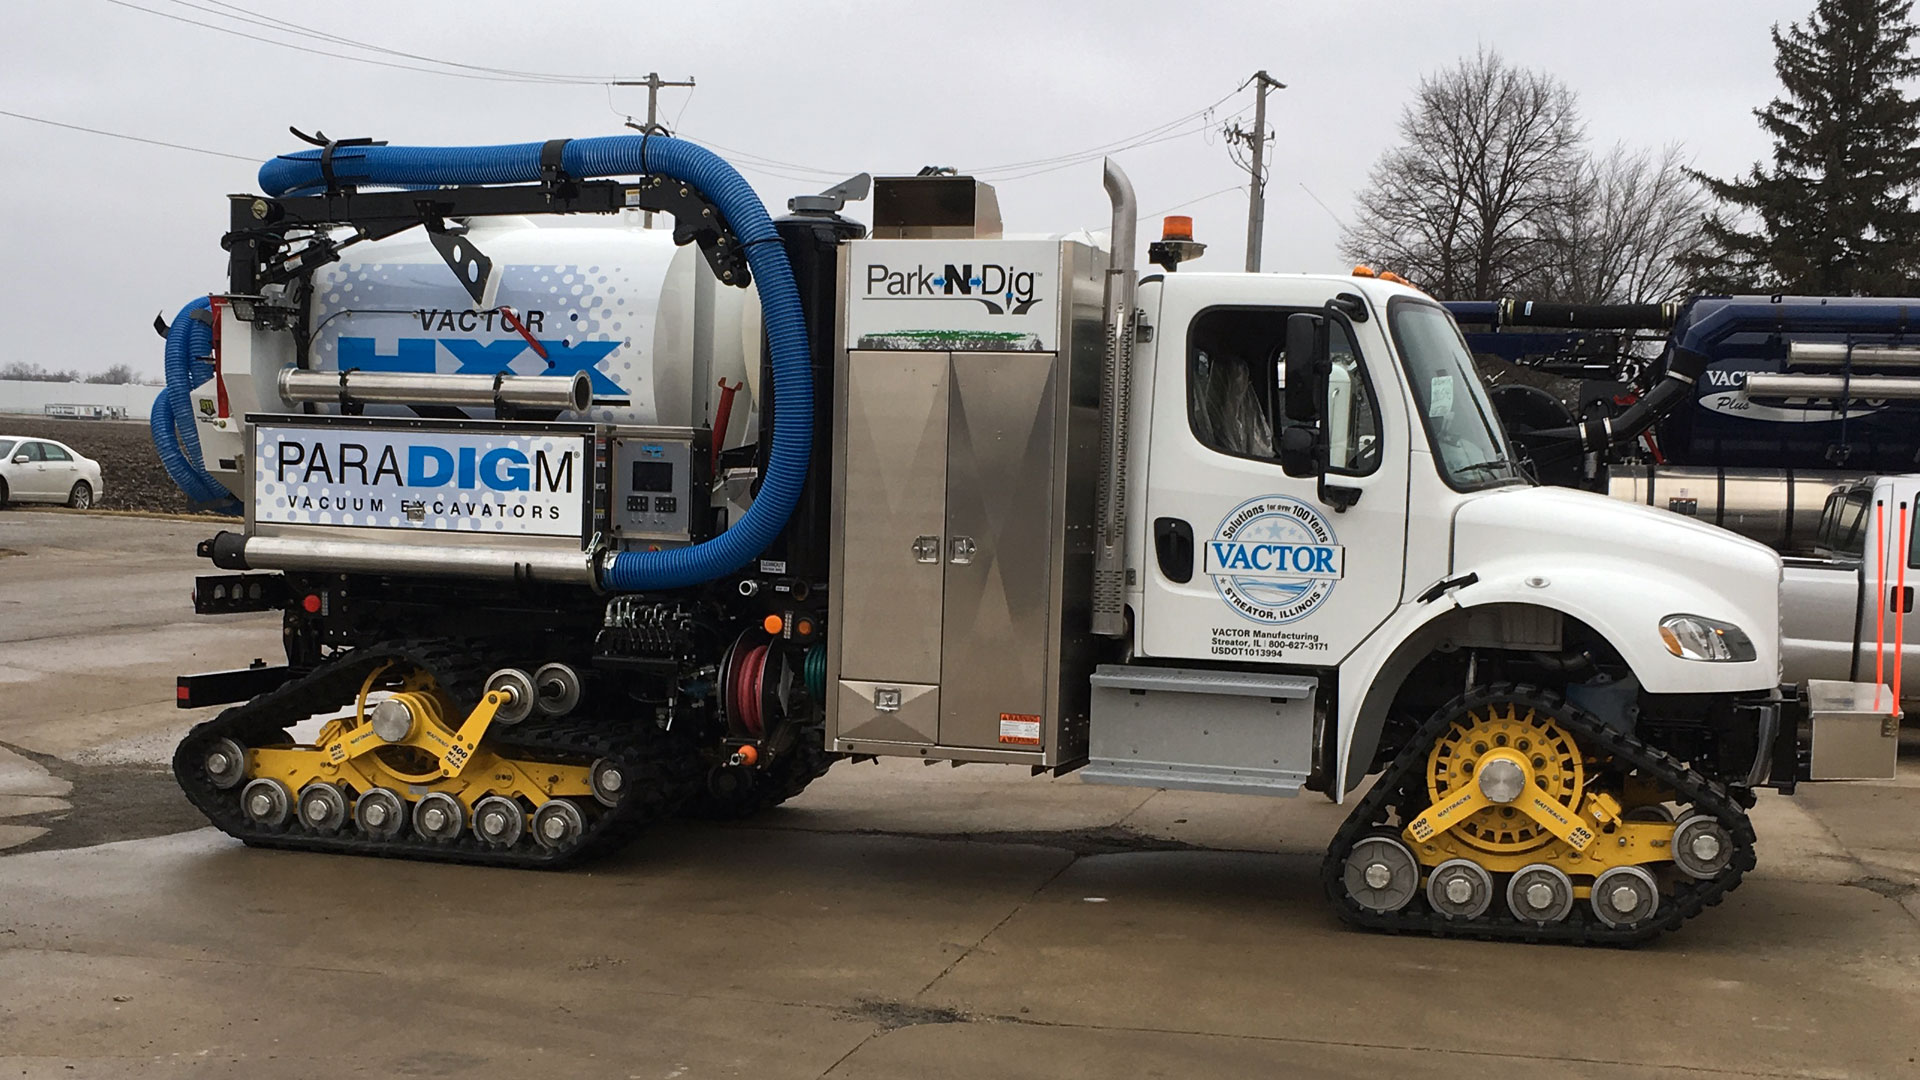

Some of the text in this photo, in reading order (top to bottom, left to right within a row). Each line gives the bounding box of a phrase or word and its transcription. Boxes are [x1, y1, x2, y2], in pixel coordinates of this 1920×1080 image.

[867, 264, 935, 295] Park
[944, 264, 972, 295] N
[419, 309, 545, 333] VACTOR
[1716, 397, 1750, 410] Plus
[287, 495, 384, 512] VACUUM
[1222, 504, 1265, 540] Solutions
[1277, 504, 1291, 512] over
[1292, 505, 1310, 521] 100
[1308, 515, 1328, 543] Years
[1211, 543, 1337, 573] VACTOR
[1225, 587, 1321, 620] STREATOR, ILLINOIS
[1211, 628, 1319, 642] VACTOR Manufacturing
[1211, 637, 1251, 648] Streator,
[1268, 640, 1328, 650] 800-627-3171
[1211, 646, 1282, 657] USDOT1013994
[452, 745, 468, 758] 400
[1412, 818, 1427, 830] 400
[1575, 827, 1592, 840] 400
